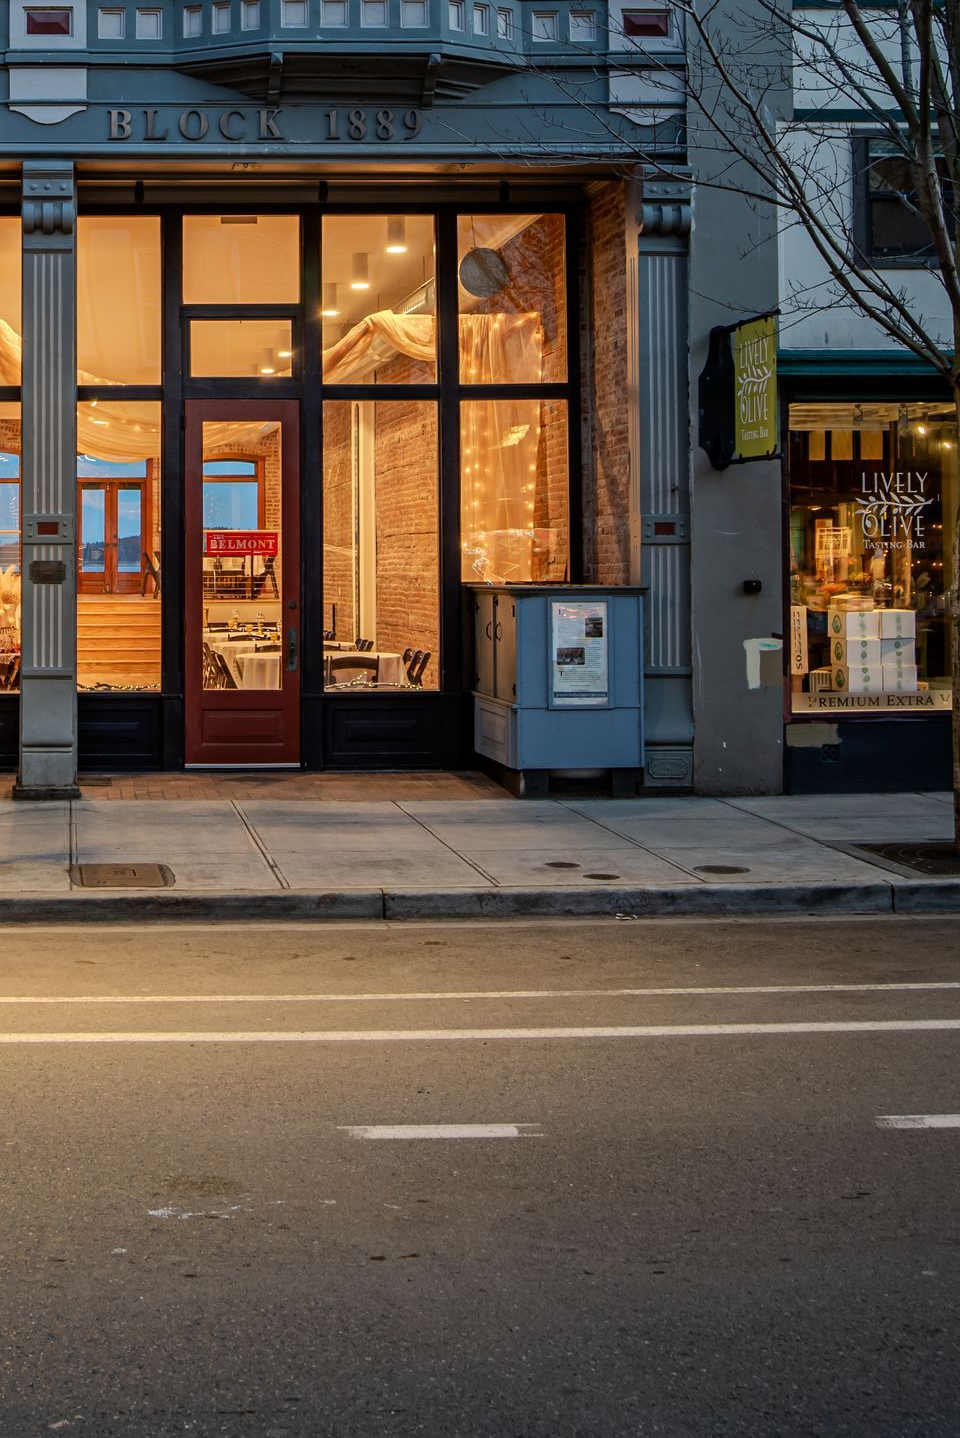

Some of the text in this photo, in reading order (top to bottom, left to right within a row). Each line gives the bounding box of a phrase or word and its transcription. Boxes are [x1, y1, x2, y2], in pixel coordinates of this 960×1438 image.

[107, 109, 285, 141] BLOCK
[324, 109, 424, 141] 1889
[740, 337, 769, 370] LIVELY
[740, 393, 769, 425] OLIVE
[861, 471, 928, 493] LIVELY
[861, 513, 926, 538] OLIVE
[209, 539, 276, 550] BELMONT
[863, 539, 926, 549] TASTING BAR
[808, 696, 881, 708] PREMIUM
[886, 694, 935, 706] EXTRA
